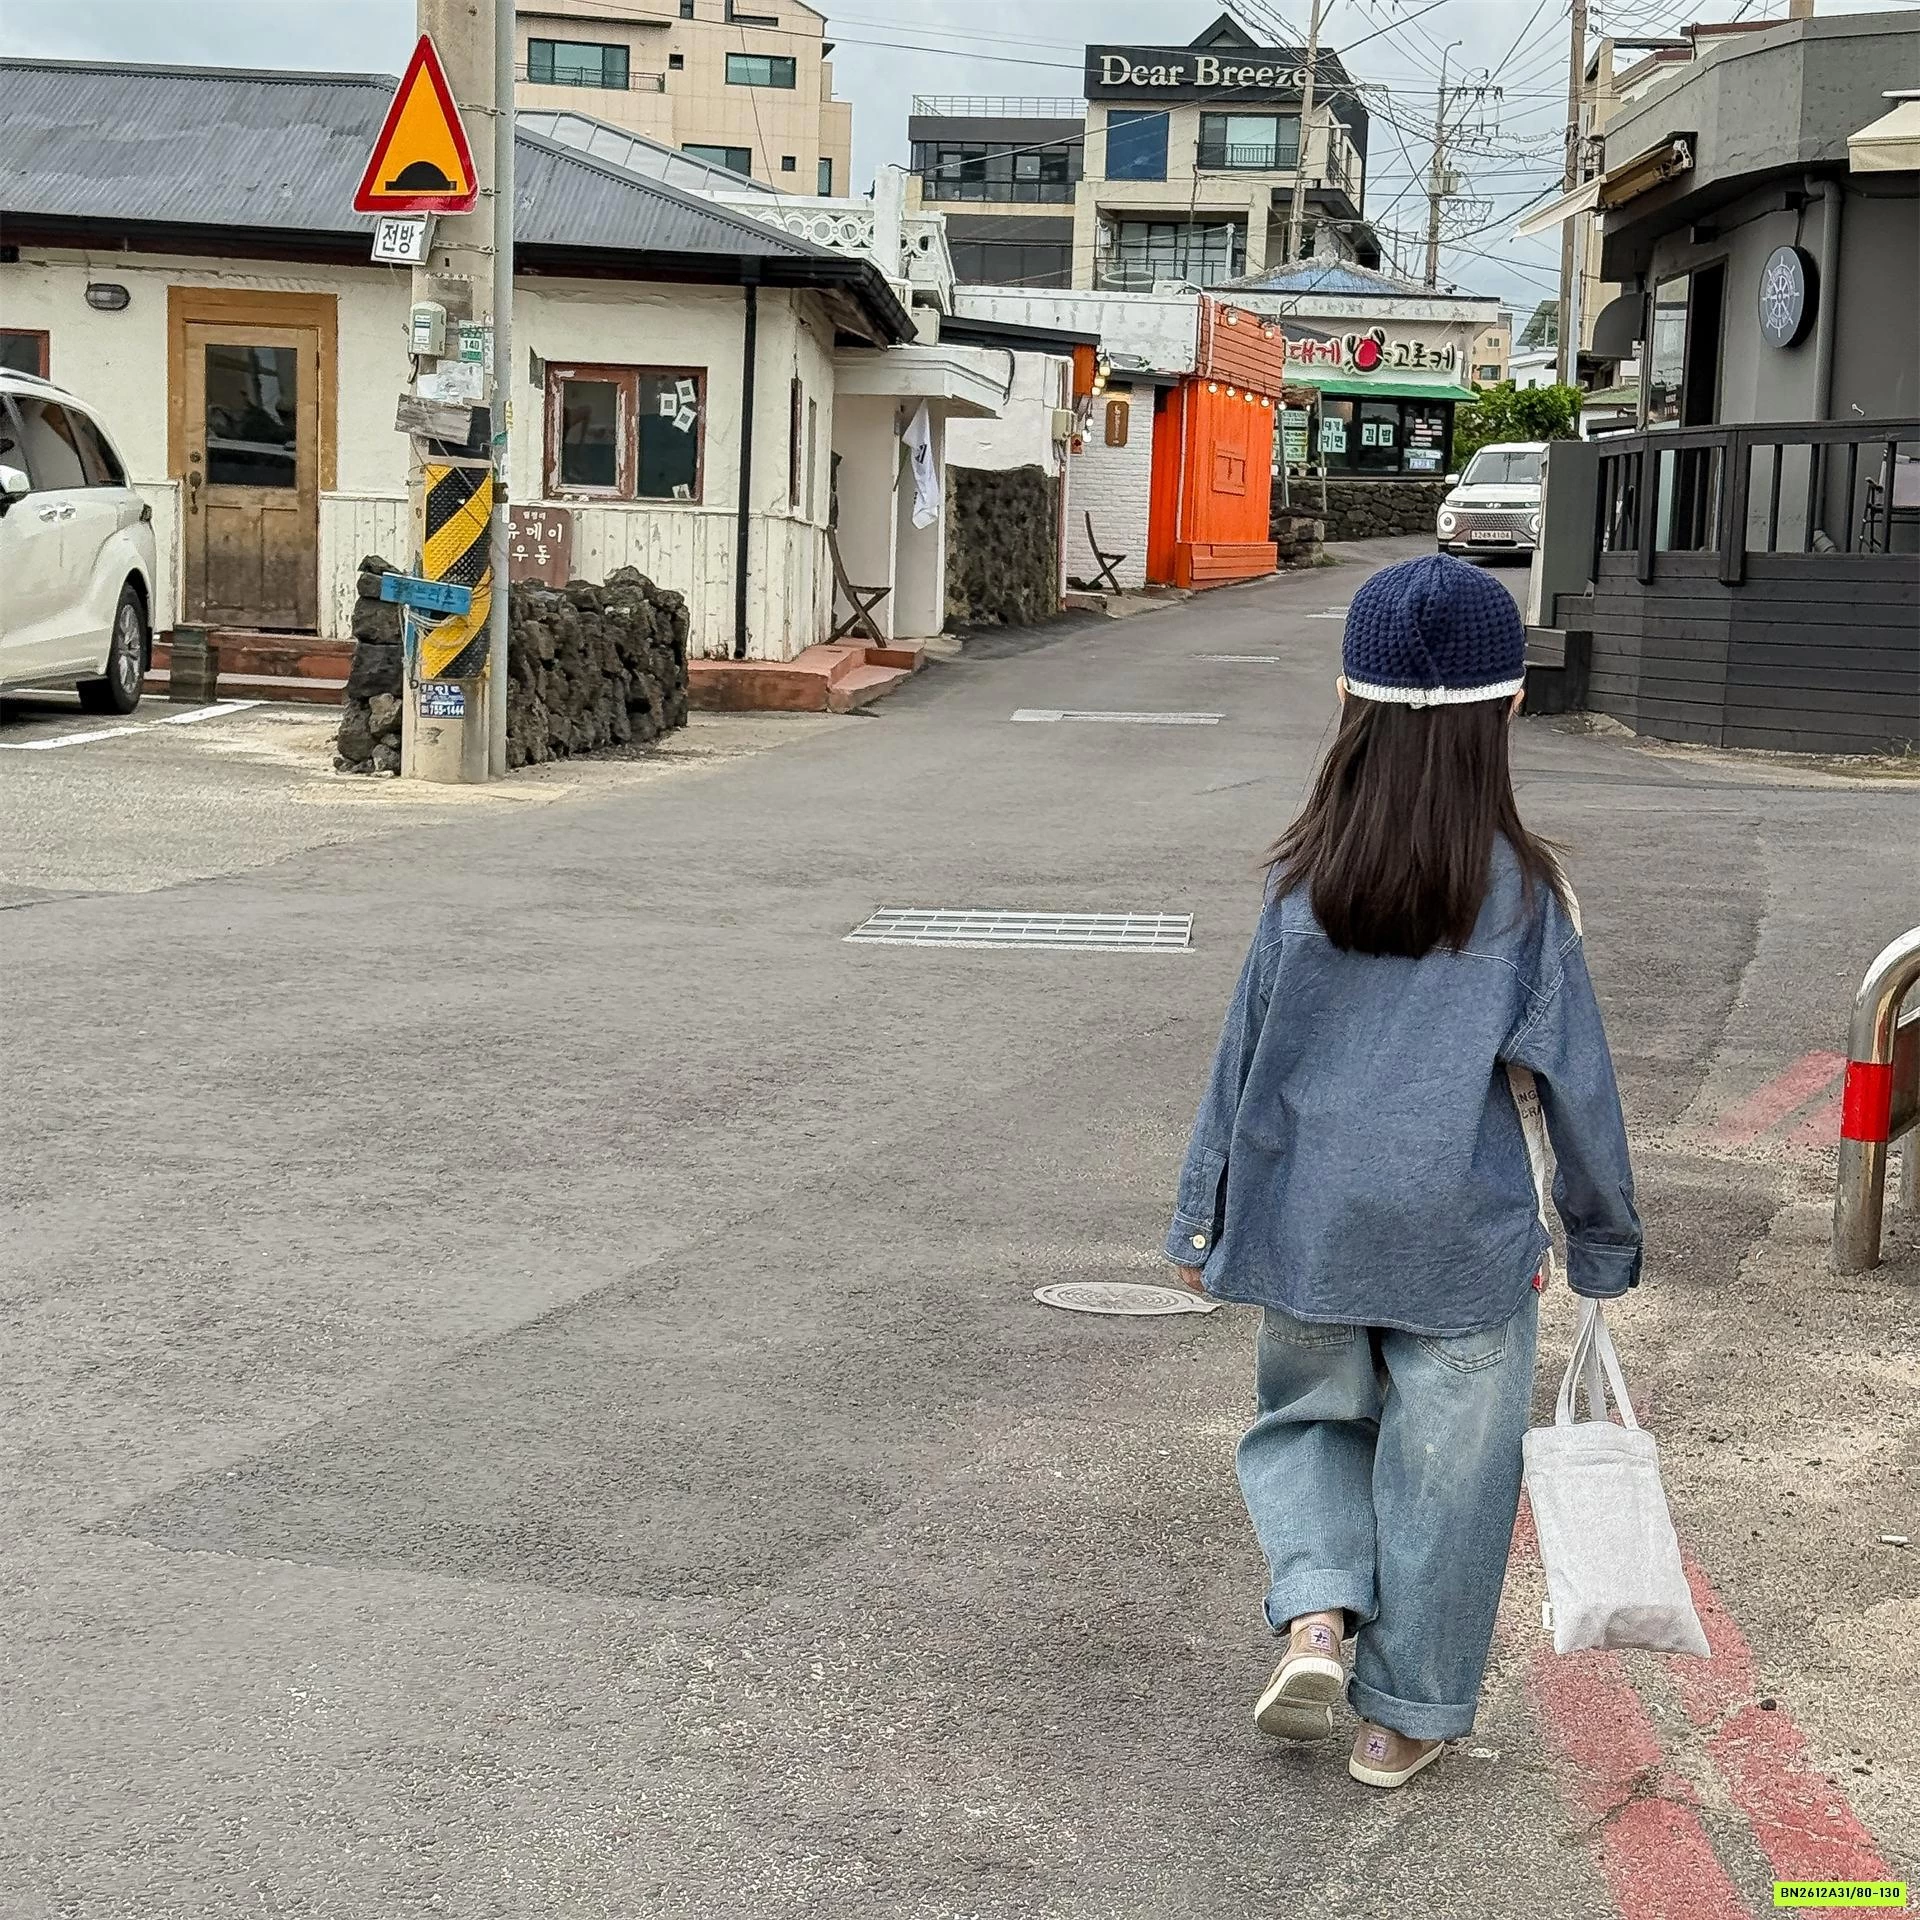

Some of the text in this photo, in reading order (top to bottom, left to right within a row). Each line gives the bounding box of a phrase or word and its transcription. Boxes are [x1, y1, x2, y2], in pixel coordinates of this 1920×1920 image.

[1100, 55, 1309, 88] Dear Breeze
[382, 223, 415, 254] 전방
[1289, 339, 1456, 370] 대게 고로케
[1365, 427, 1392, 443] 김밥
[508, 522, 563, 543] 유메이
[511, 544, 551, 565] 우동
